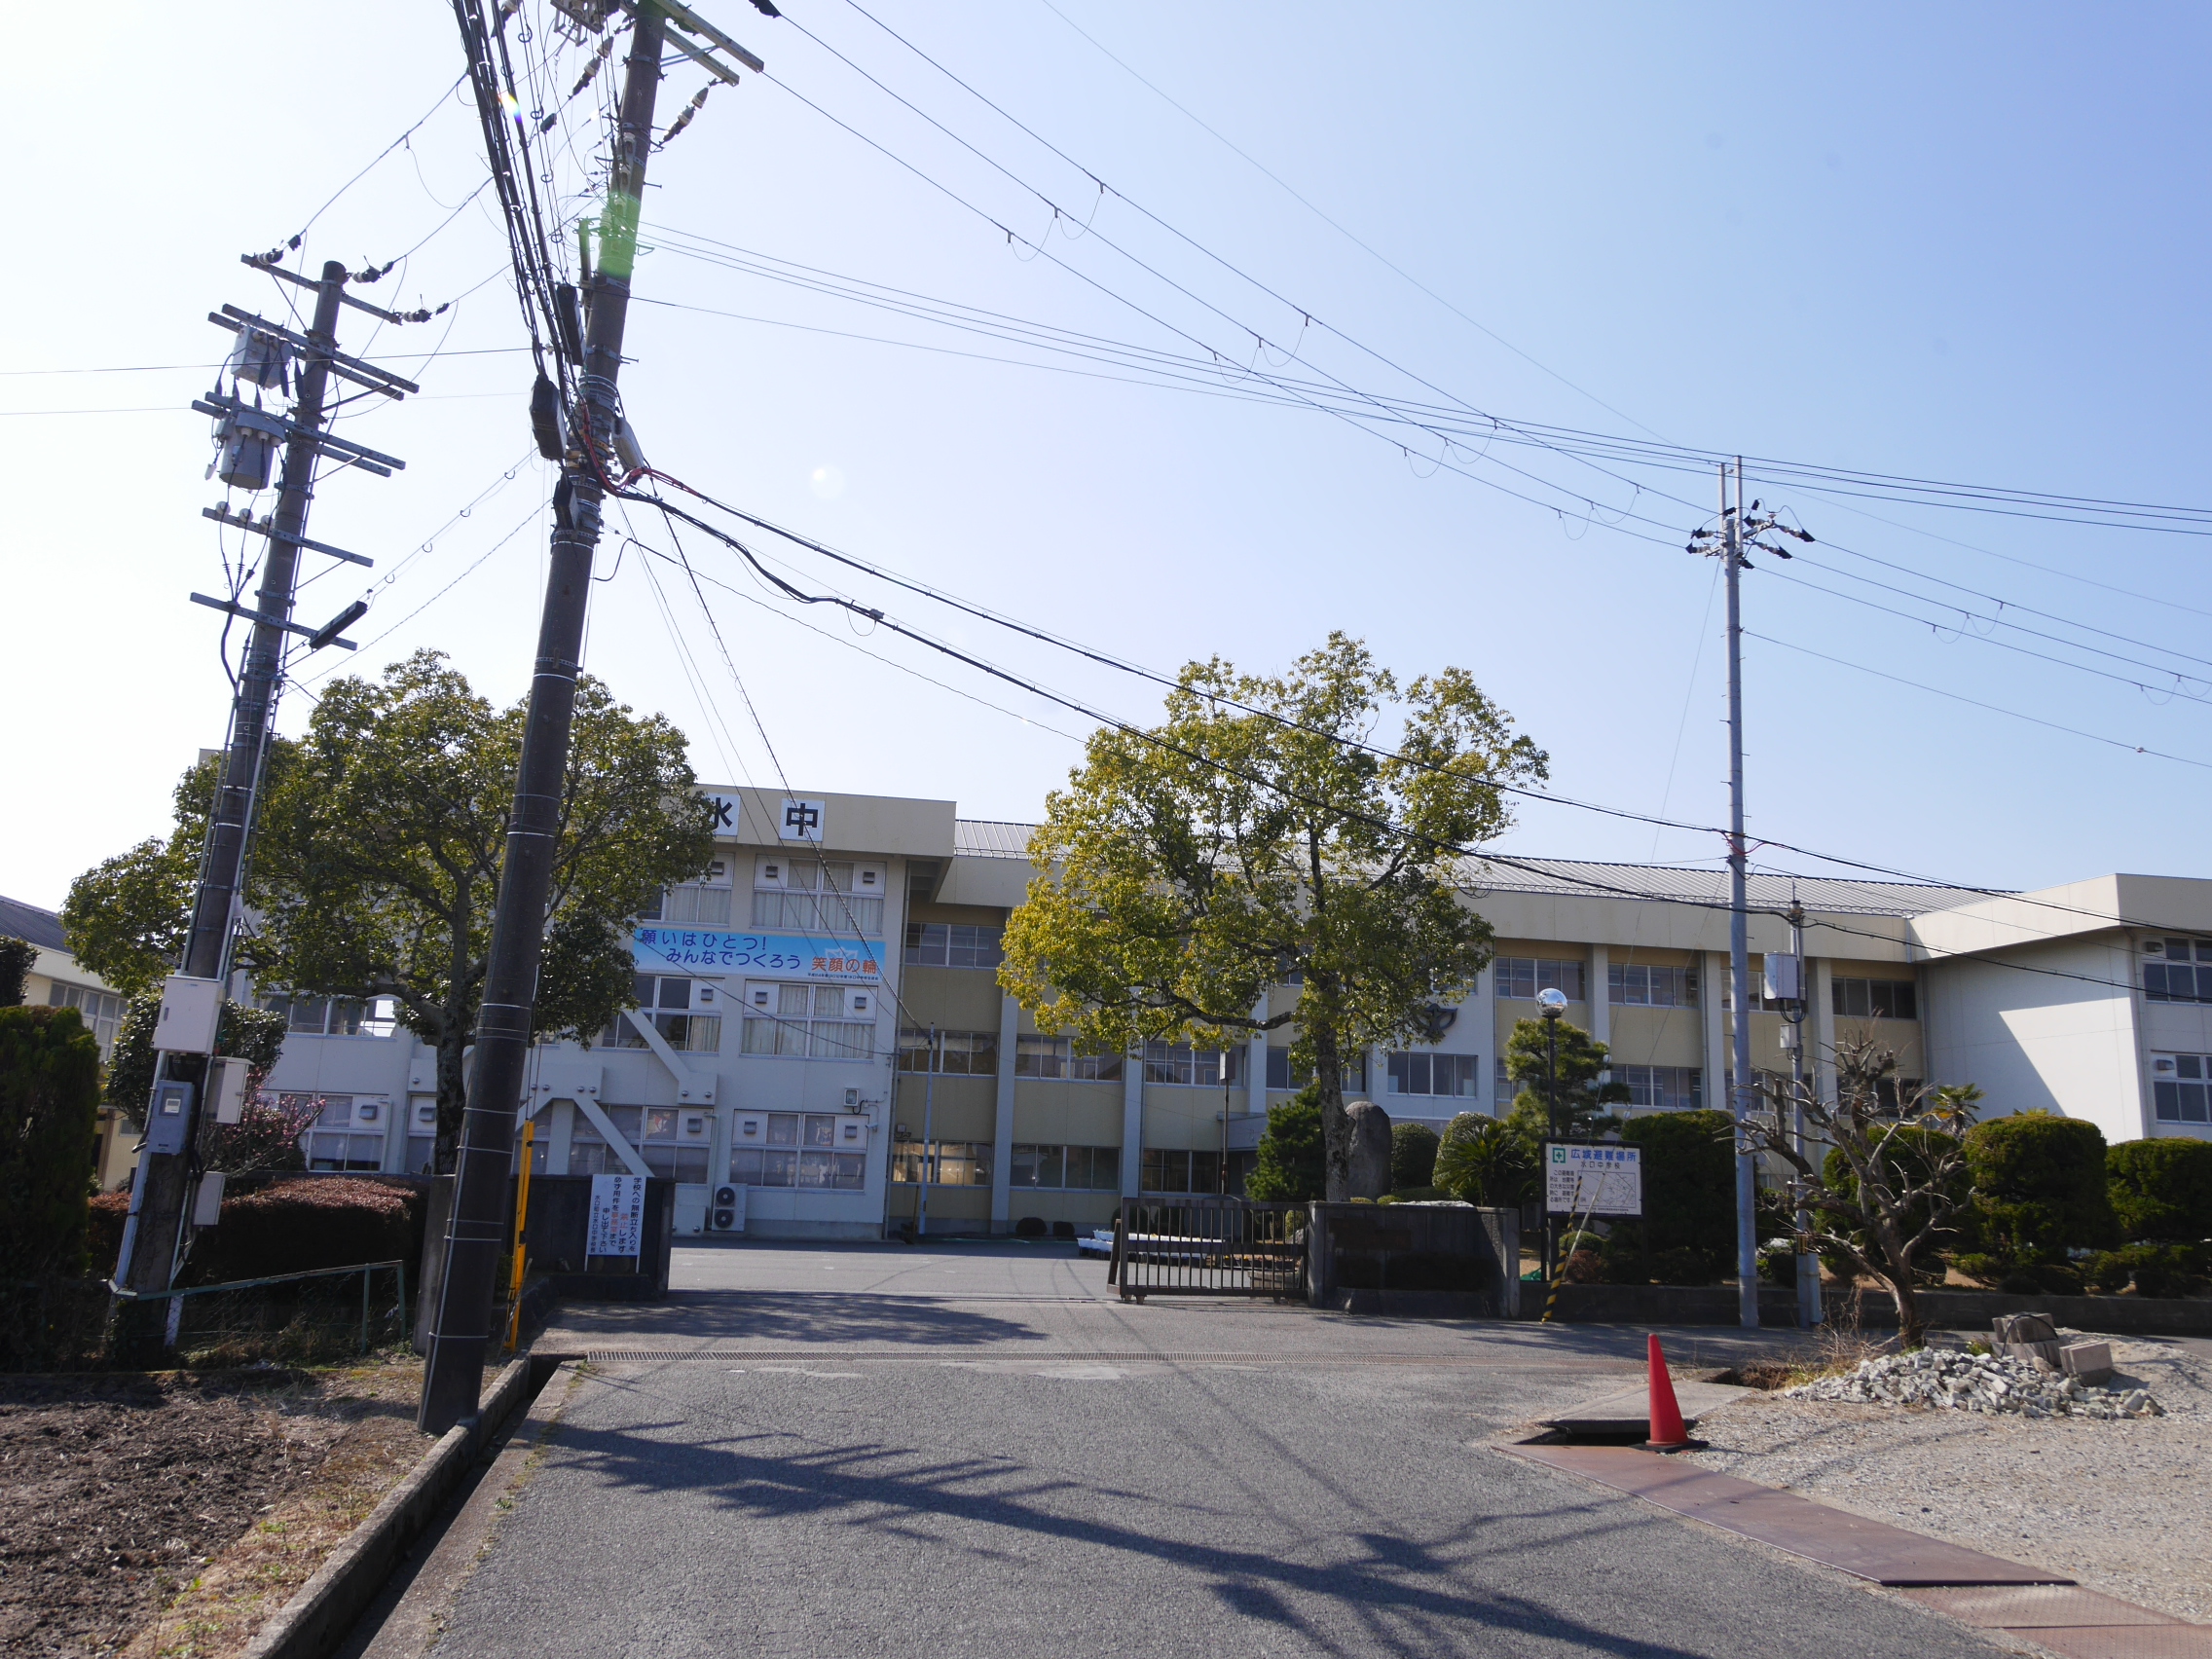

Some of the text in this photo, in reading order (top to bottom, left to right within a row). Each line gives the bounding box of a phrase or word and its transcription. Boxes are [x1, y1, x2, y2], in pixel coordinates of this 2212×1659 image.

[666, 946, 877, 975] みんなでつくろう 笑顔の輪
[1570, 1149, 1637, 1162] 広域避難場所
[599, 1207, 610, 1253] 申し出て下さい
[617, 1213, 629, 1254] 禁止します
[629, 1177, 642, 1252] 学校への無断立ち入りを
